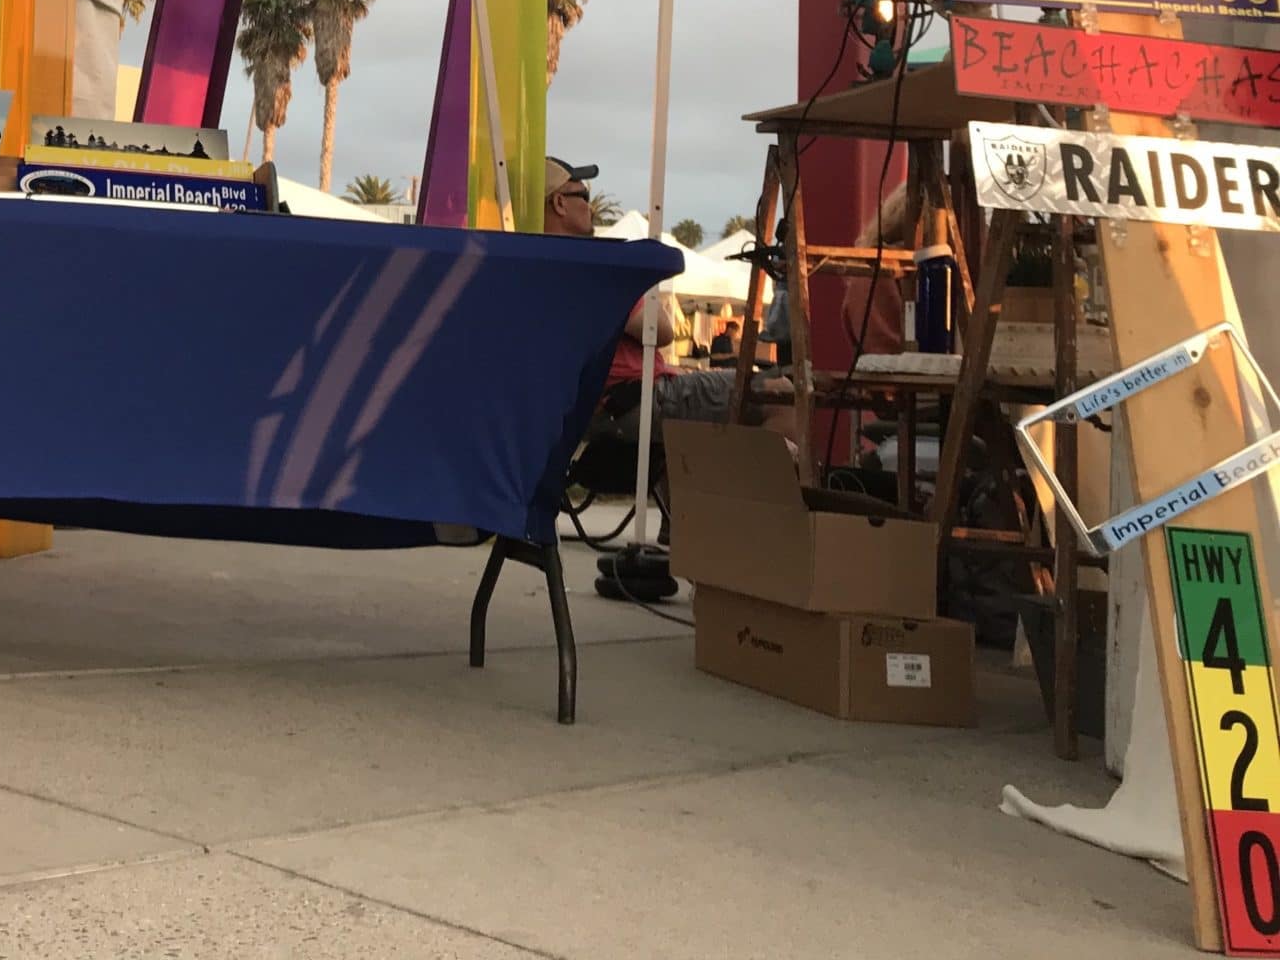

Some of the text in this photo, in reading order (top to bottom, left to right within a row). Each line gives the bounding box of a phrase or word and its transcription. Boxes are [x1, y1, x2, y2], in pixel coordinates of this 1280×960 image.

[1154, 1, 1263, 17] Imperial Beach
[221, 185, 247, 201] Blvd
[1059, 142, 1280, 218] RAIDER
[1081, 353, 1188, 414] Life's better in
[1111, 480, 1209, 542] Imperial
[1181, 543, 1243, 586] HWY
